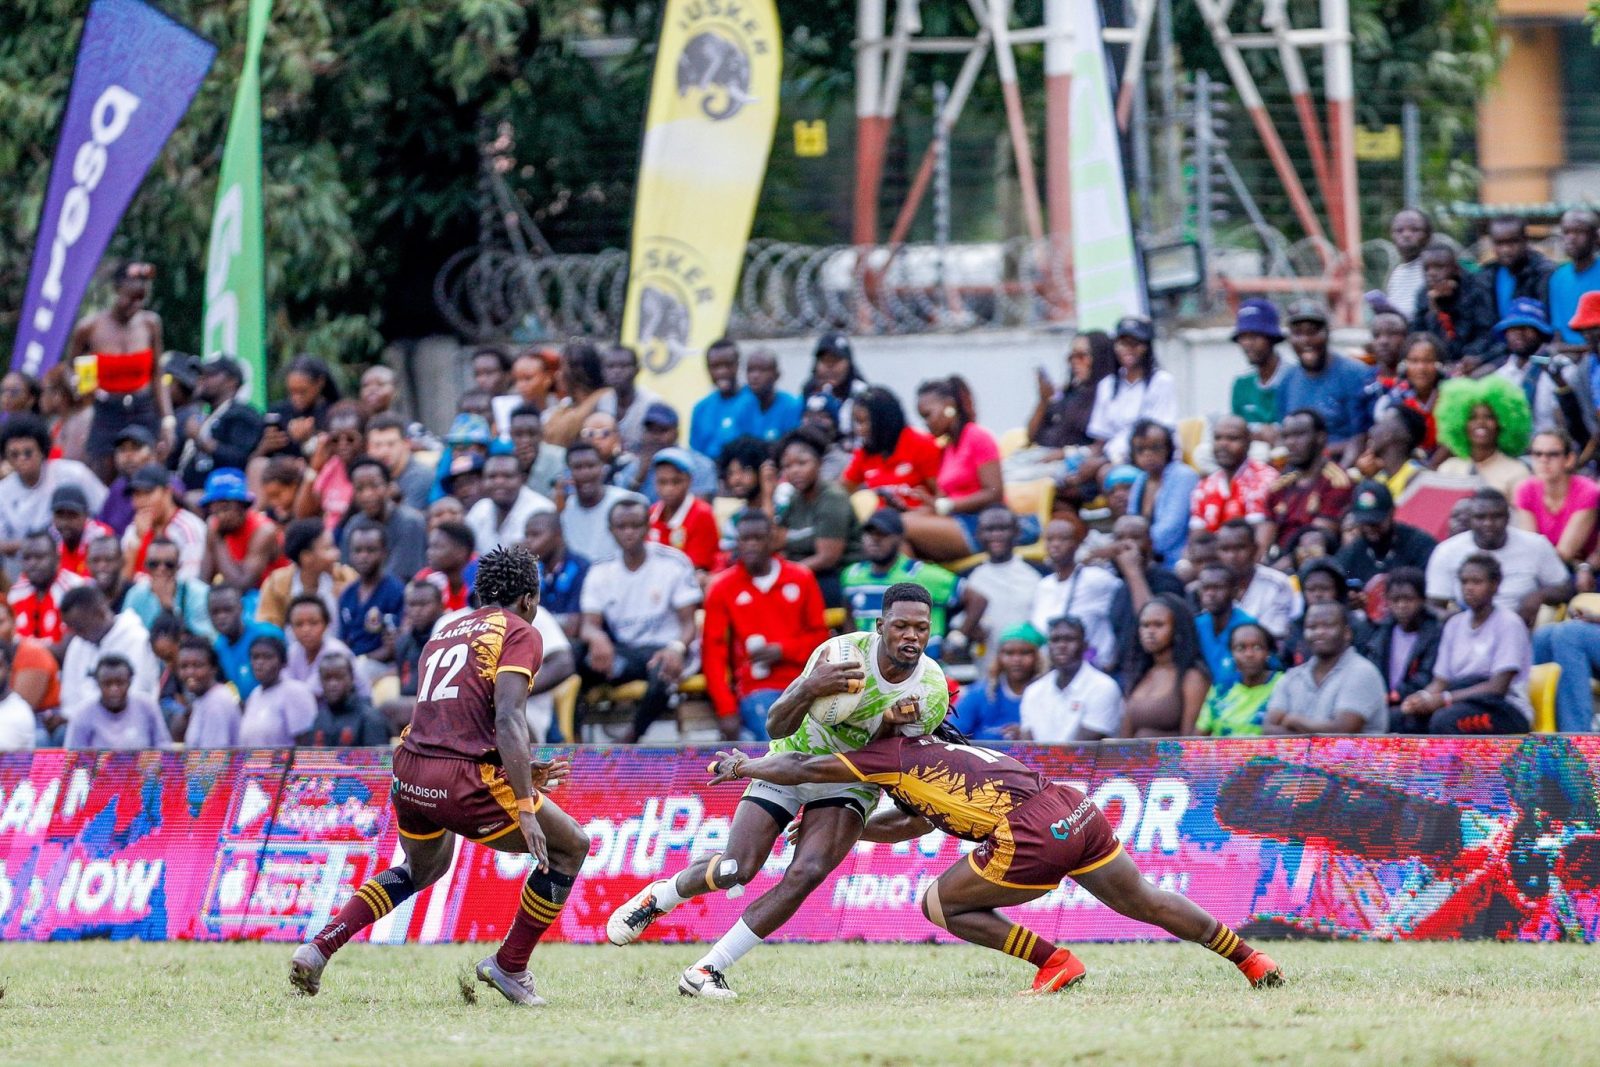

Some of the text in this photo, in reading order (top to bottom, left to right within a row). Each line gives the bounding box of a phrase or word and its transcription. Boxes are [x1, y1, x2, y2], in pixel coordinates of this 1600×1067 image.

[418, 643, 469, 702] 12
[400, 781, 448, 799] MADISON
[1052, 776, 1192, 856] OR
